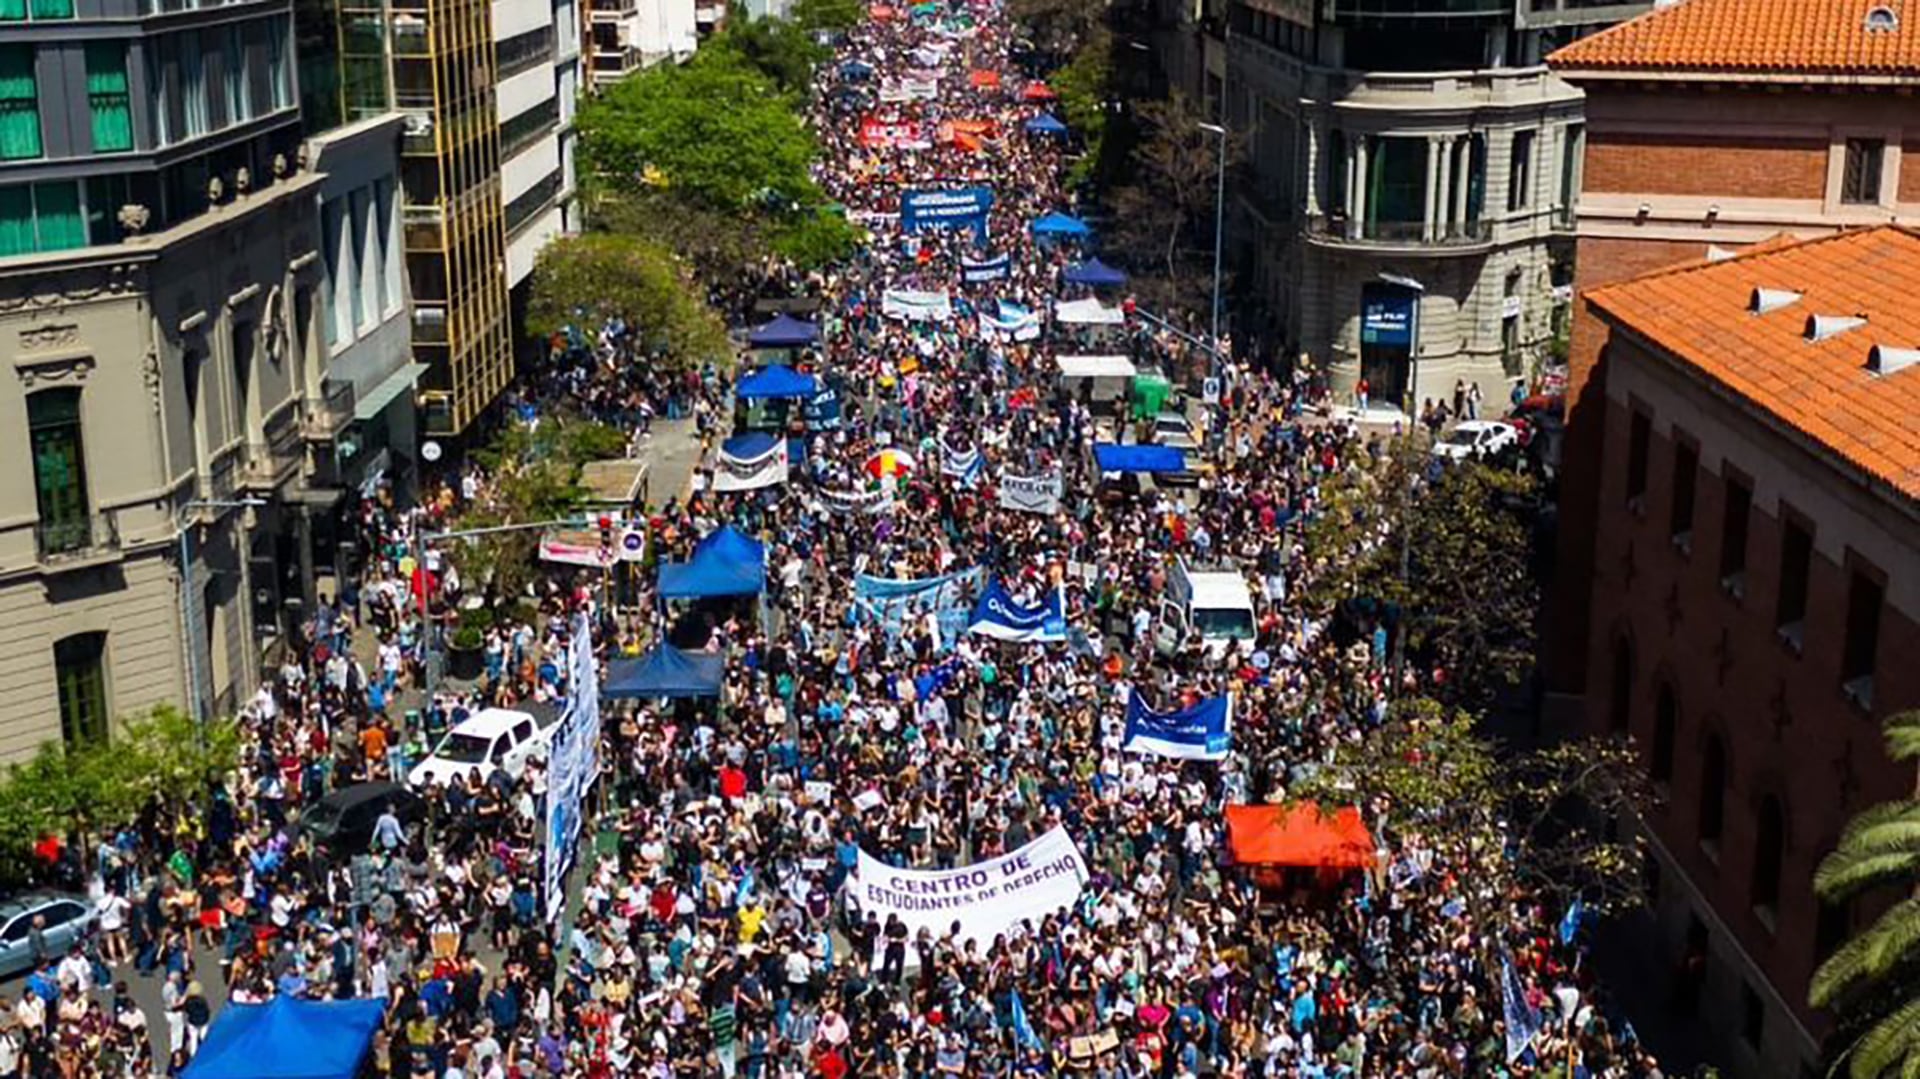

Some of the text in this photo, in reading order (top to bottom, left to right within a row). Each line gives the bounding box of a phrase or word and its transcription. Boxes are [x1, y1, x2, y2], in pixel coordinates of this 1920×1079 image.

[890, 853, 1032, 895] CENTRO DE
[867, 884, 975, 911] ESTUDIANTES
